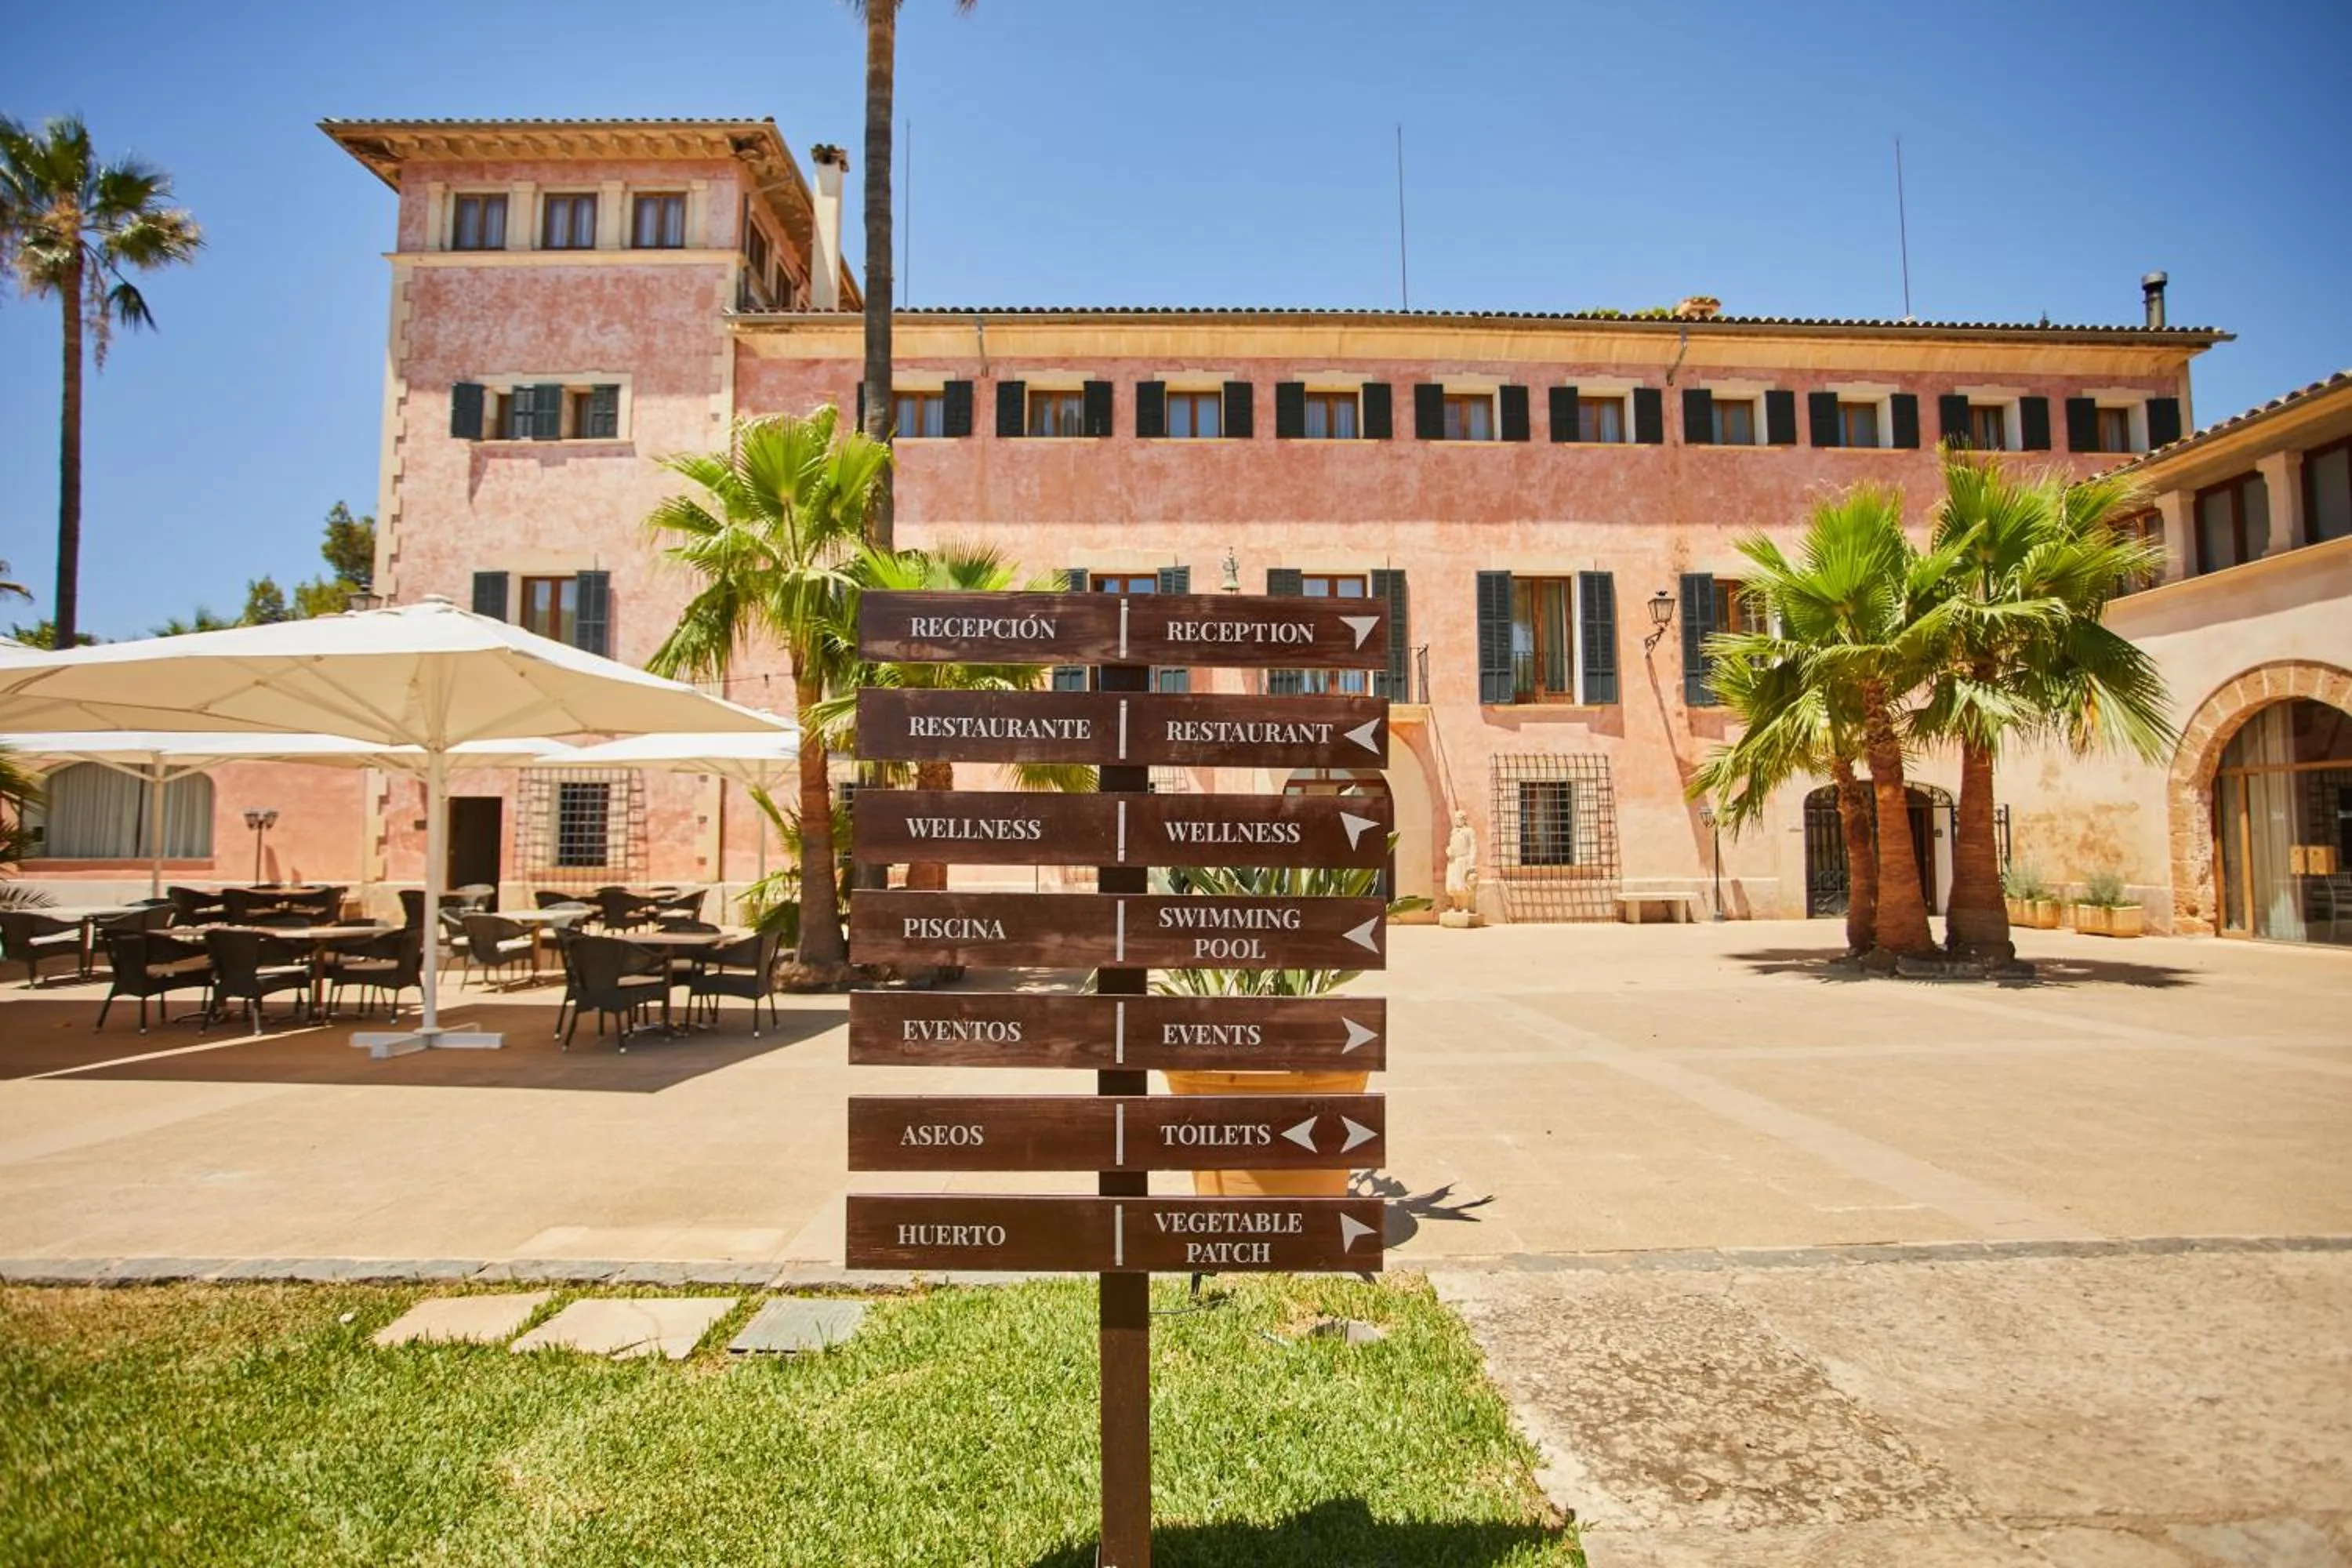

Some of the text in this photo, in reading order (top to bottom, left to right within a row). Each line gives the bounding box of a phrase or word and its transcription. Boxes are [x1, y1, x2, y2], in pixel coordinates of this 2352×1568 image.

[911, 614, 1054, 639] RECEPCIÓN
[1167, 622, 1313, 642] RECEPTION
[909, 716, 1091, 739] RESTAURANTE
[1167, 720, 1333, 743] RESTAURANT
[906, 818, 1041, 840] WELLNESS
[1165, 822, 1300, 843] WELLNESS
[904, 918, 1005, 939] PISCINA
[1160, 907, 1300, 929] SWIMMING
[1195, 938, 1265, 959] POOL
[903, 1020, 1021, 1042] EVENTOS
[1163, 1024, 1261, 1045] EVENTS
[900, 1125, 983, 1145] ASEOS
[1155, 1213, 1302, 1232] VEGETABLE
[898, 1225, 1006, 1246] HUERTO
[1187, 1243, 1270, 1263] PATCH
